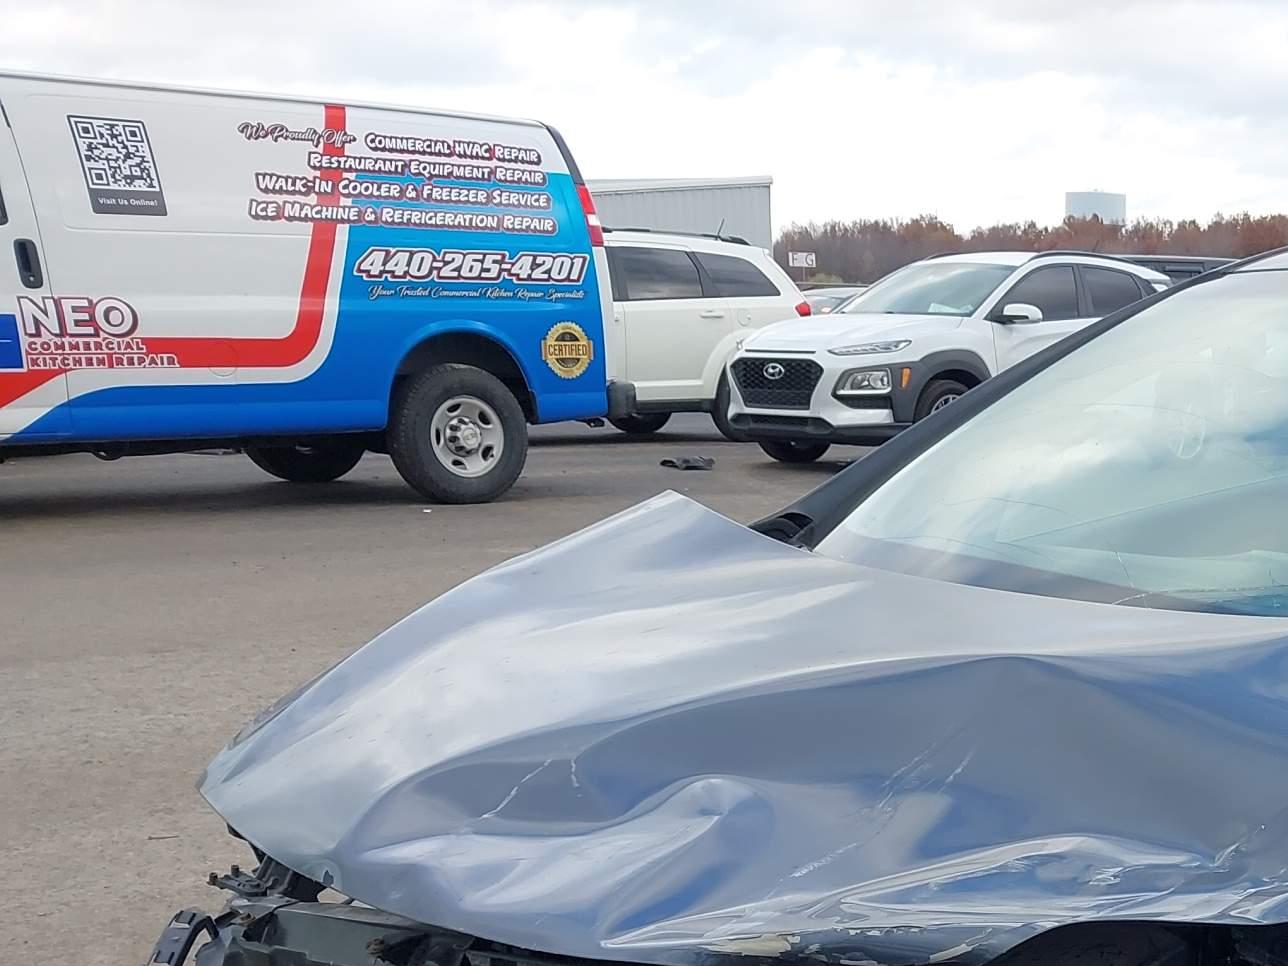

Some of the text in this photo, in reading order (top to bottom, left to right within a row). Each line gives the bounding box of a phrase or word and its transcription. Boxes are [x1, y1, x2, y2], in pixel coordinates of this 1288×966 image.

[238, 122, 357, 148] We Proudly Offer
[366, 133, 540, 163] COMMERCIAL HVAC REPAIR
[309, 152, 545, 184] RESTAURANT EQUIPMENT REPAIR
[98, 197, 116, 205] Visit
[256, 174, 548, 207] WALK-IN COOLER & FREEZER SERVICE
[250, 200, 554, 231] ICE MACHINE & REFRIGERATION REPAIR
[356, 248, 586, 282] 440-265-4201
[368, 284, 395, 300] Your
[397, 285, 430, 297] Trusted
[431, 286, 481, 298] Commercial
[482, 286, 513, 299] Kitchen
[514, 288, 545, 302] Repair
[17, 295, 139, 338] NEO
[27, 338, 145, 353] COMMERCIAL
[548, 343, 588, 357] CERTIFIED
[28, 354, 180, 369] KITCHEN REPAIR
